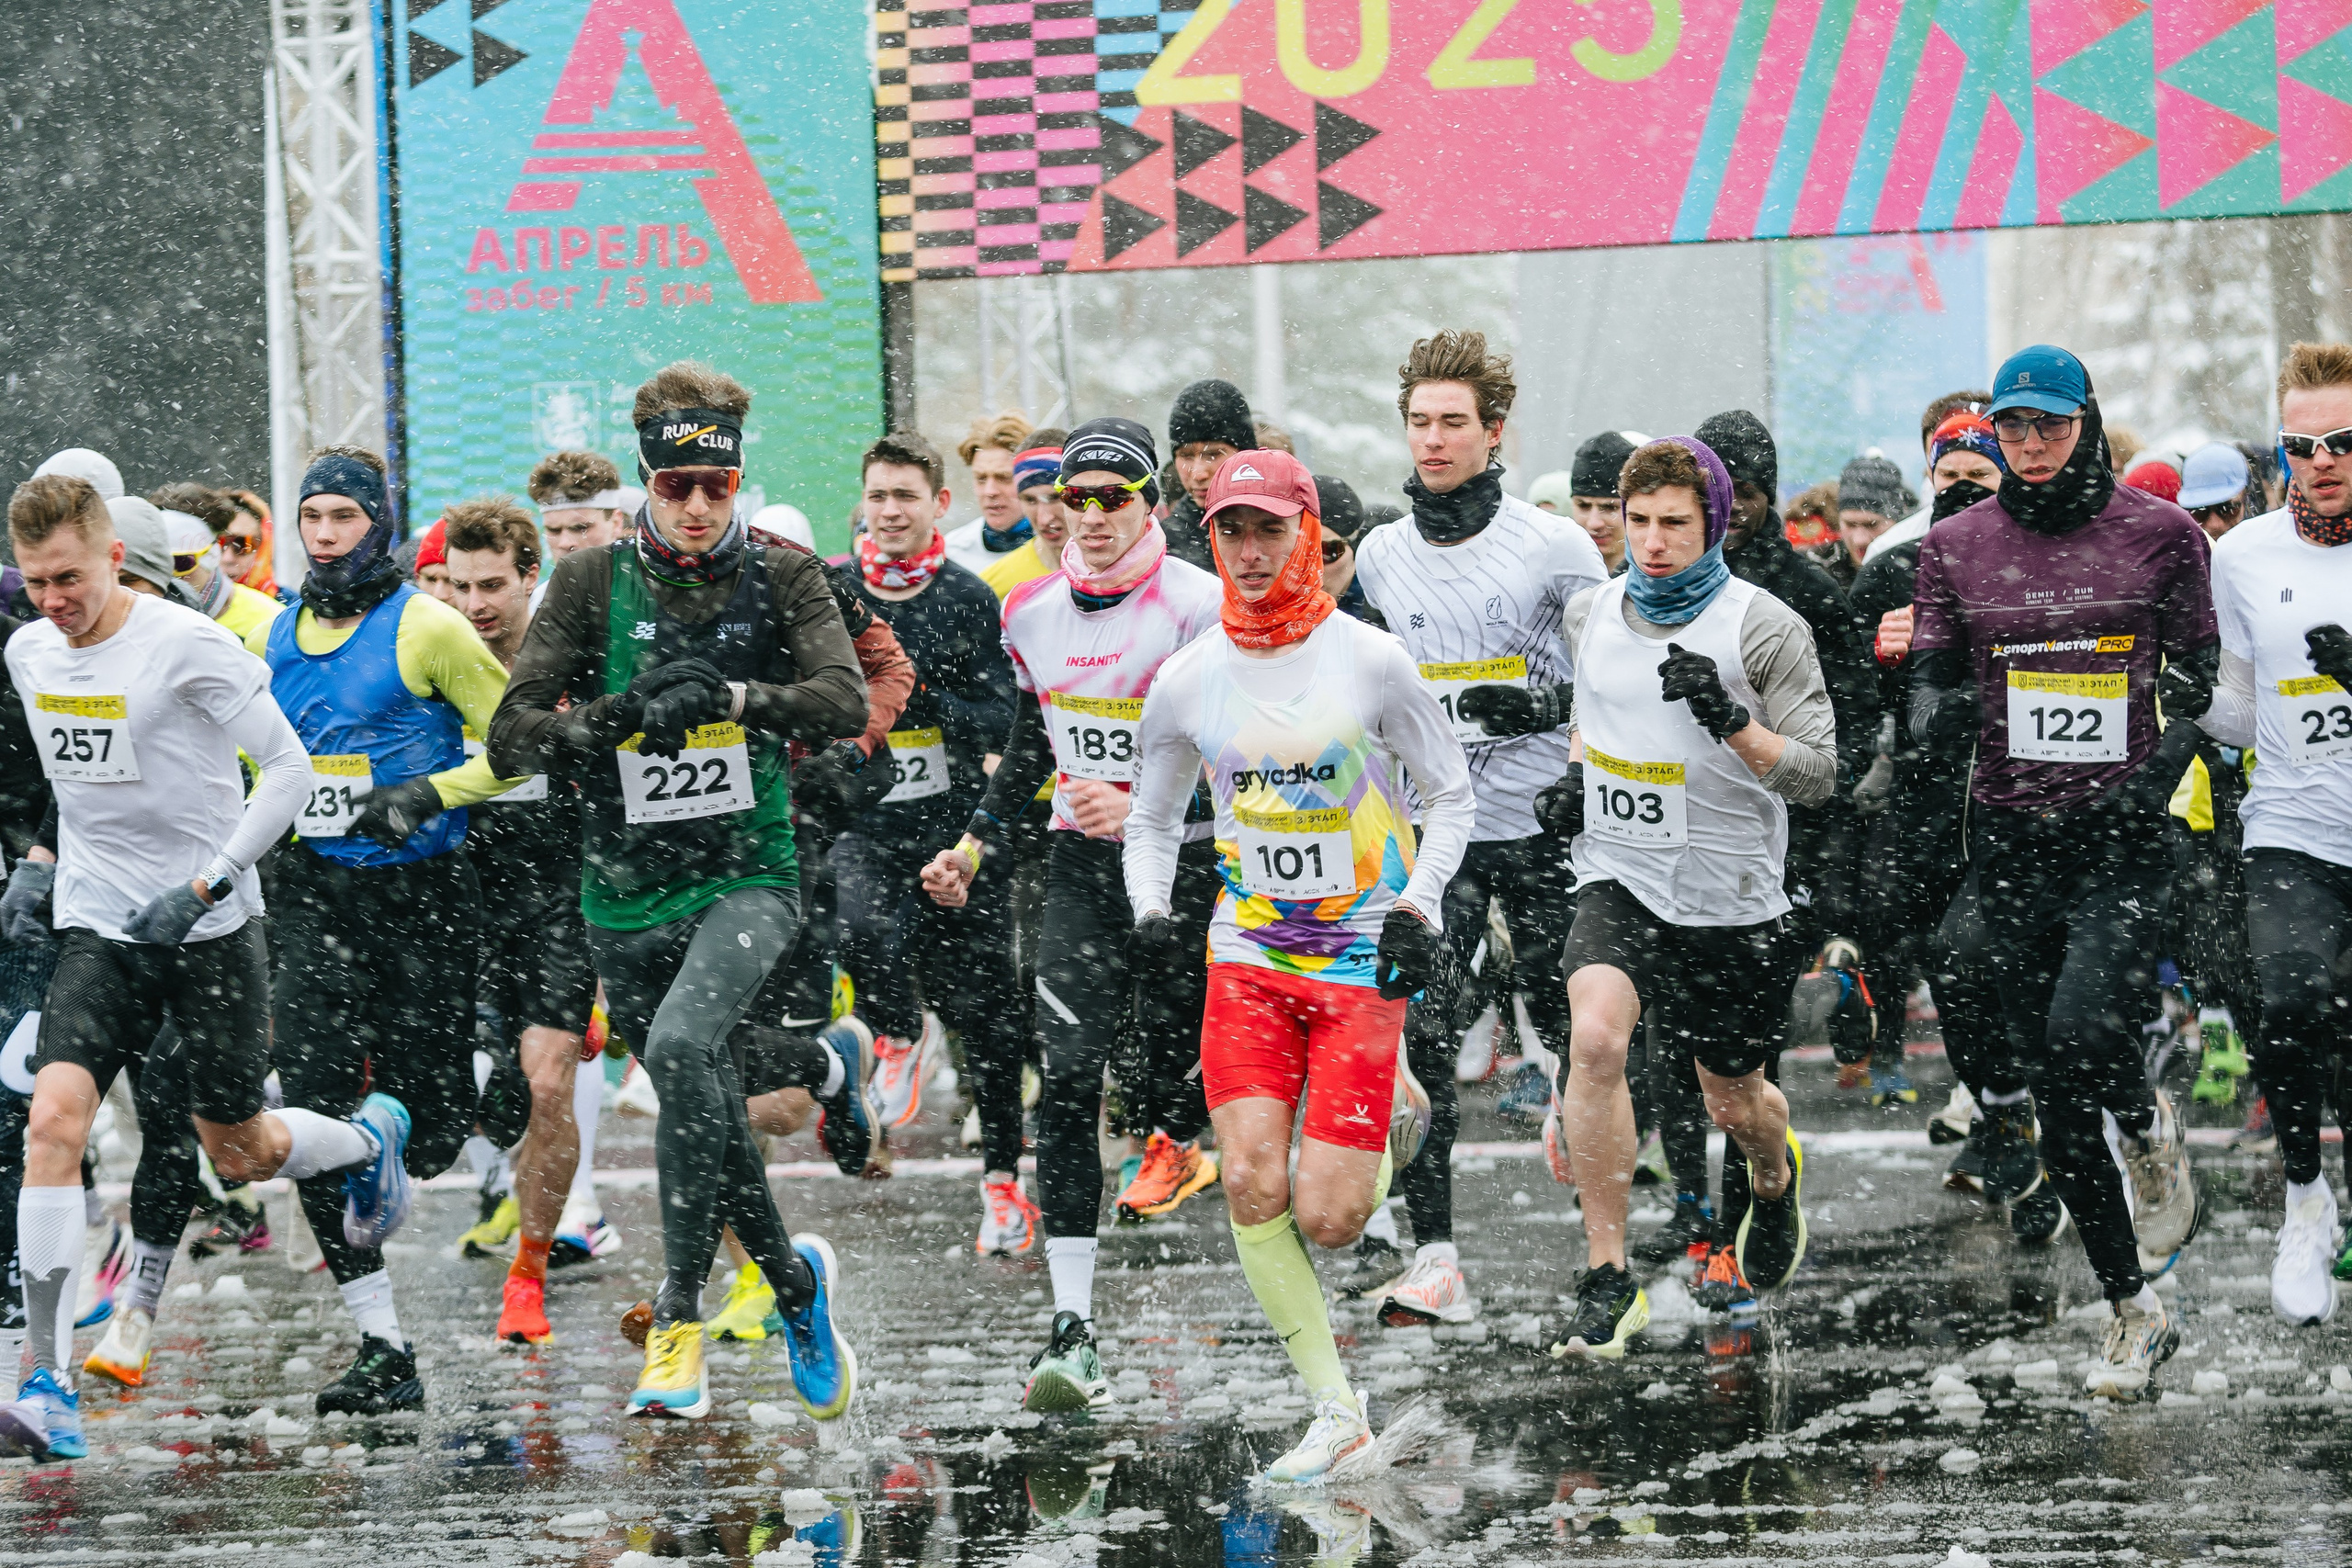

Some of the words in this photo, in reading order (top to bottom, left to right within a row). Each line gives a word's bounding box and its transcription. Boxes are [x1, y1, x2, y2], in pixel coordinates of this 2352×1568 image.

[466, 223, 711, 274] АПРЕЛЬ
[465, 278, 582, 313] забег
[626, 276, 648, 309] 5
[661, 282, 713, 307] км
[662, 423, 699, 441] RUN
[697, 433, 733, 452] CLUB
[2025, 590, 2055, 600] DEMIX
[2074, 586, 2094, 595] RUN
[2099, 637, 2133, 650] PRO
[1066, 652, 1123, 668] INSANITY
[1489, 661, 1515, 671] ЭТАП
[2090, 680, 2117, 688] ЭТАП
[705, 727, 734, 739] ЭТАП
[2030, 706, 2103, 742] 122
[51, 728, 113, 762] 257
[1068, 726, 1134, 762] 183
[641, 758, 731, 802] 222
[1231, 762, 1336, 793] gryadka
[1645, 766, 1674, 774] ЭТАП
[304, 785, 355, 818] 231
[1597, 784, 1664, 824] 103
[1296, 816, 1304, 824] 3
[1307, 813, 1338, 822] ЭТАП
[1256, 842, 1323, 880] 101
